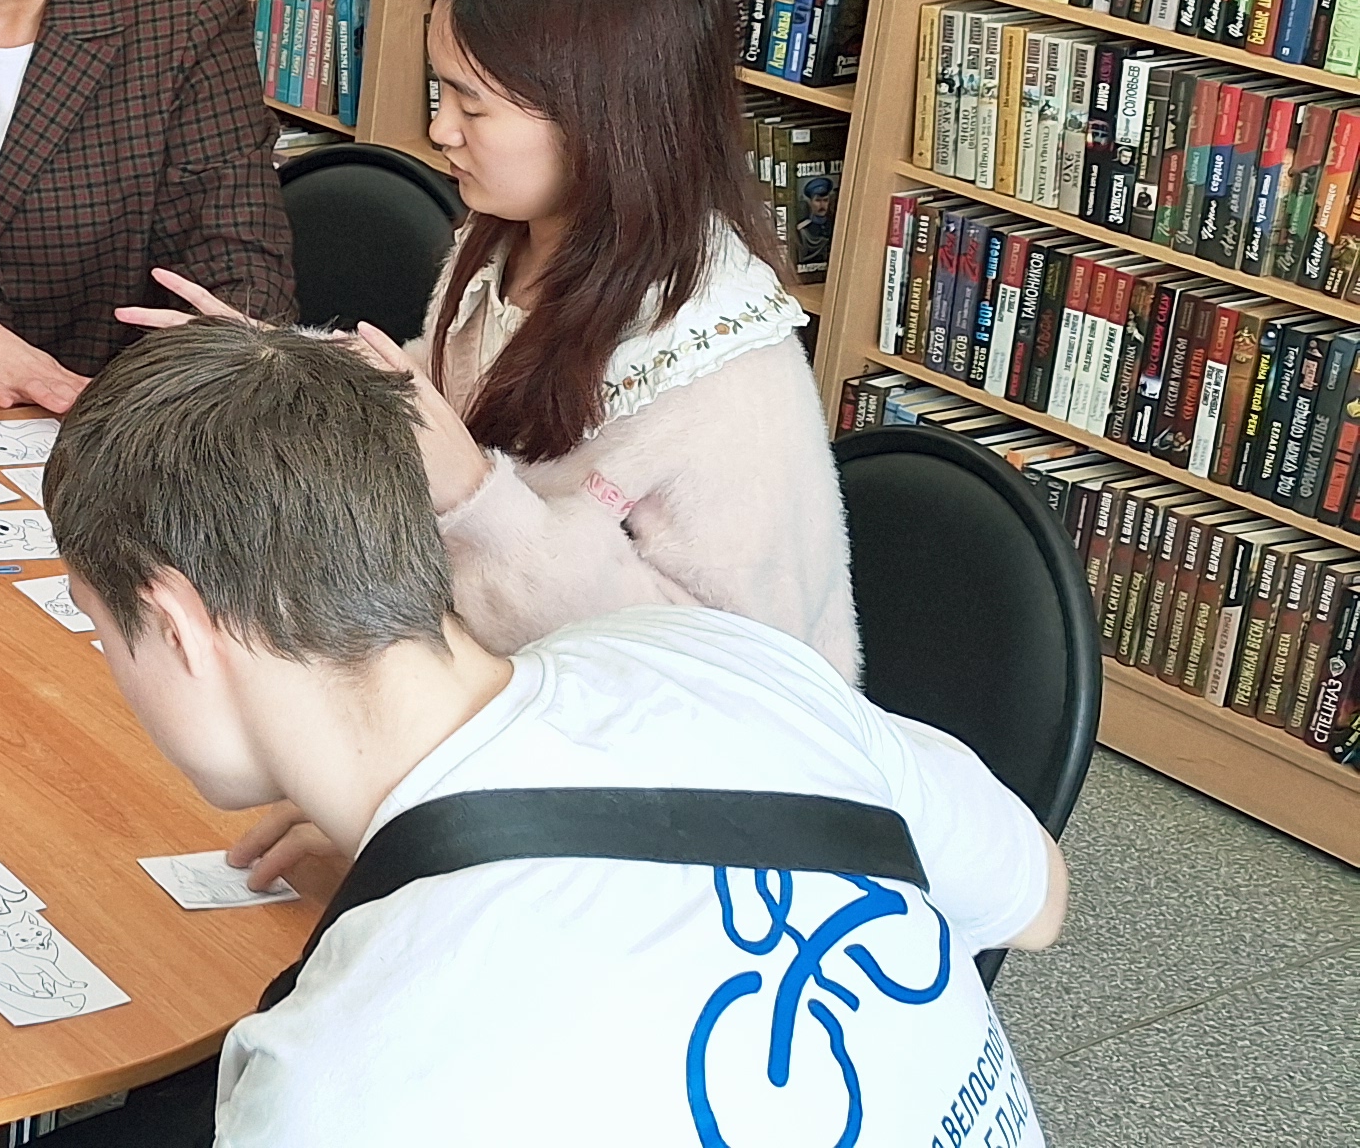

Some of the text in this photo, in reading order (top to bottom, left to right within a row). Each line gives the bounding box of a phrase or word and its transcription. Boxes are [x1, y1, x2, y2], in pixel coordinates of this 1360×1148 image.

[1245, 11, 1270, 45] Бедные
[1096, 82, 1110, 111] СМИТ
[1062, 152, 1074, 183] ЭХО
[1210, 154, 1224, 192] сердце
[1318, 183, 1337, 227] настоящее
[1021, 252, 1044, 319] ТАМОНИКОВ
[906, 277, 923, 354] СТАЛЬНАЯ ПАМЯТЬ
[931, 327, 945, 363] СУХОВ
[952, 335, 968, 372] СУХОВ
[1266, 422, 1282, 453] БЕЛАЯ
[1276, 476, 1296, 496] ПОД
[1234, 619, 1265, 706] ТРЕВОЖНАЯ ВЕСНА
[1314, 679, 1343, 743] СПЕЦНАЗ
